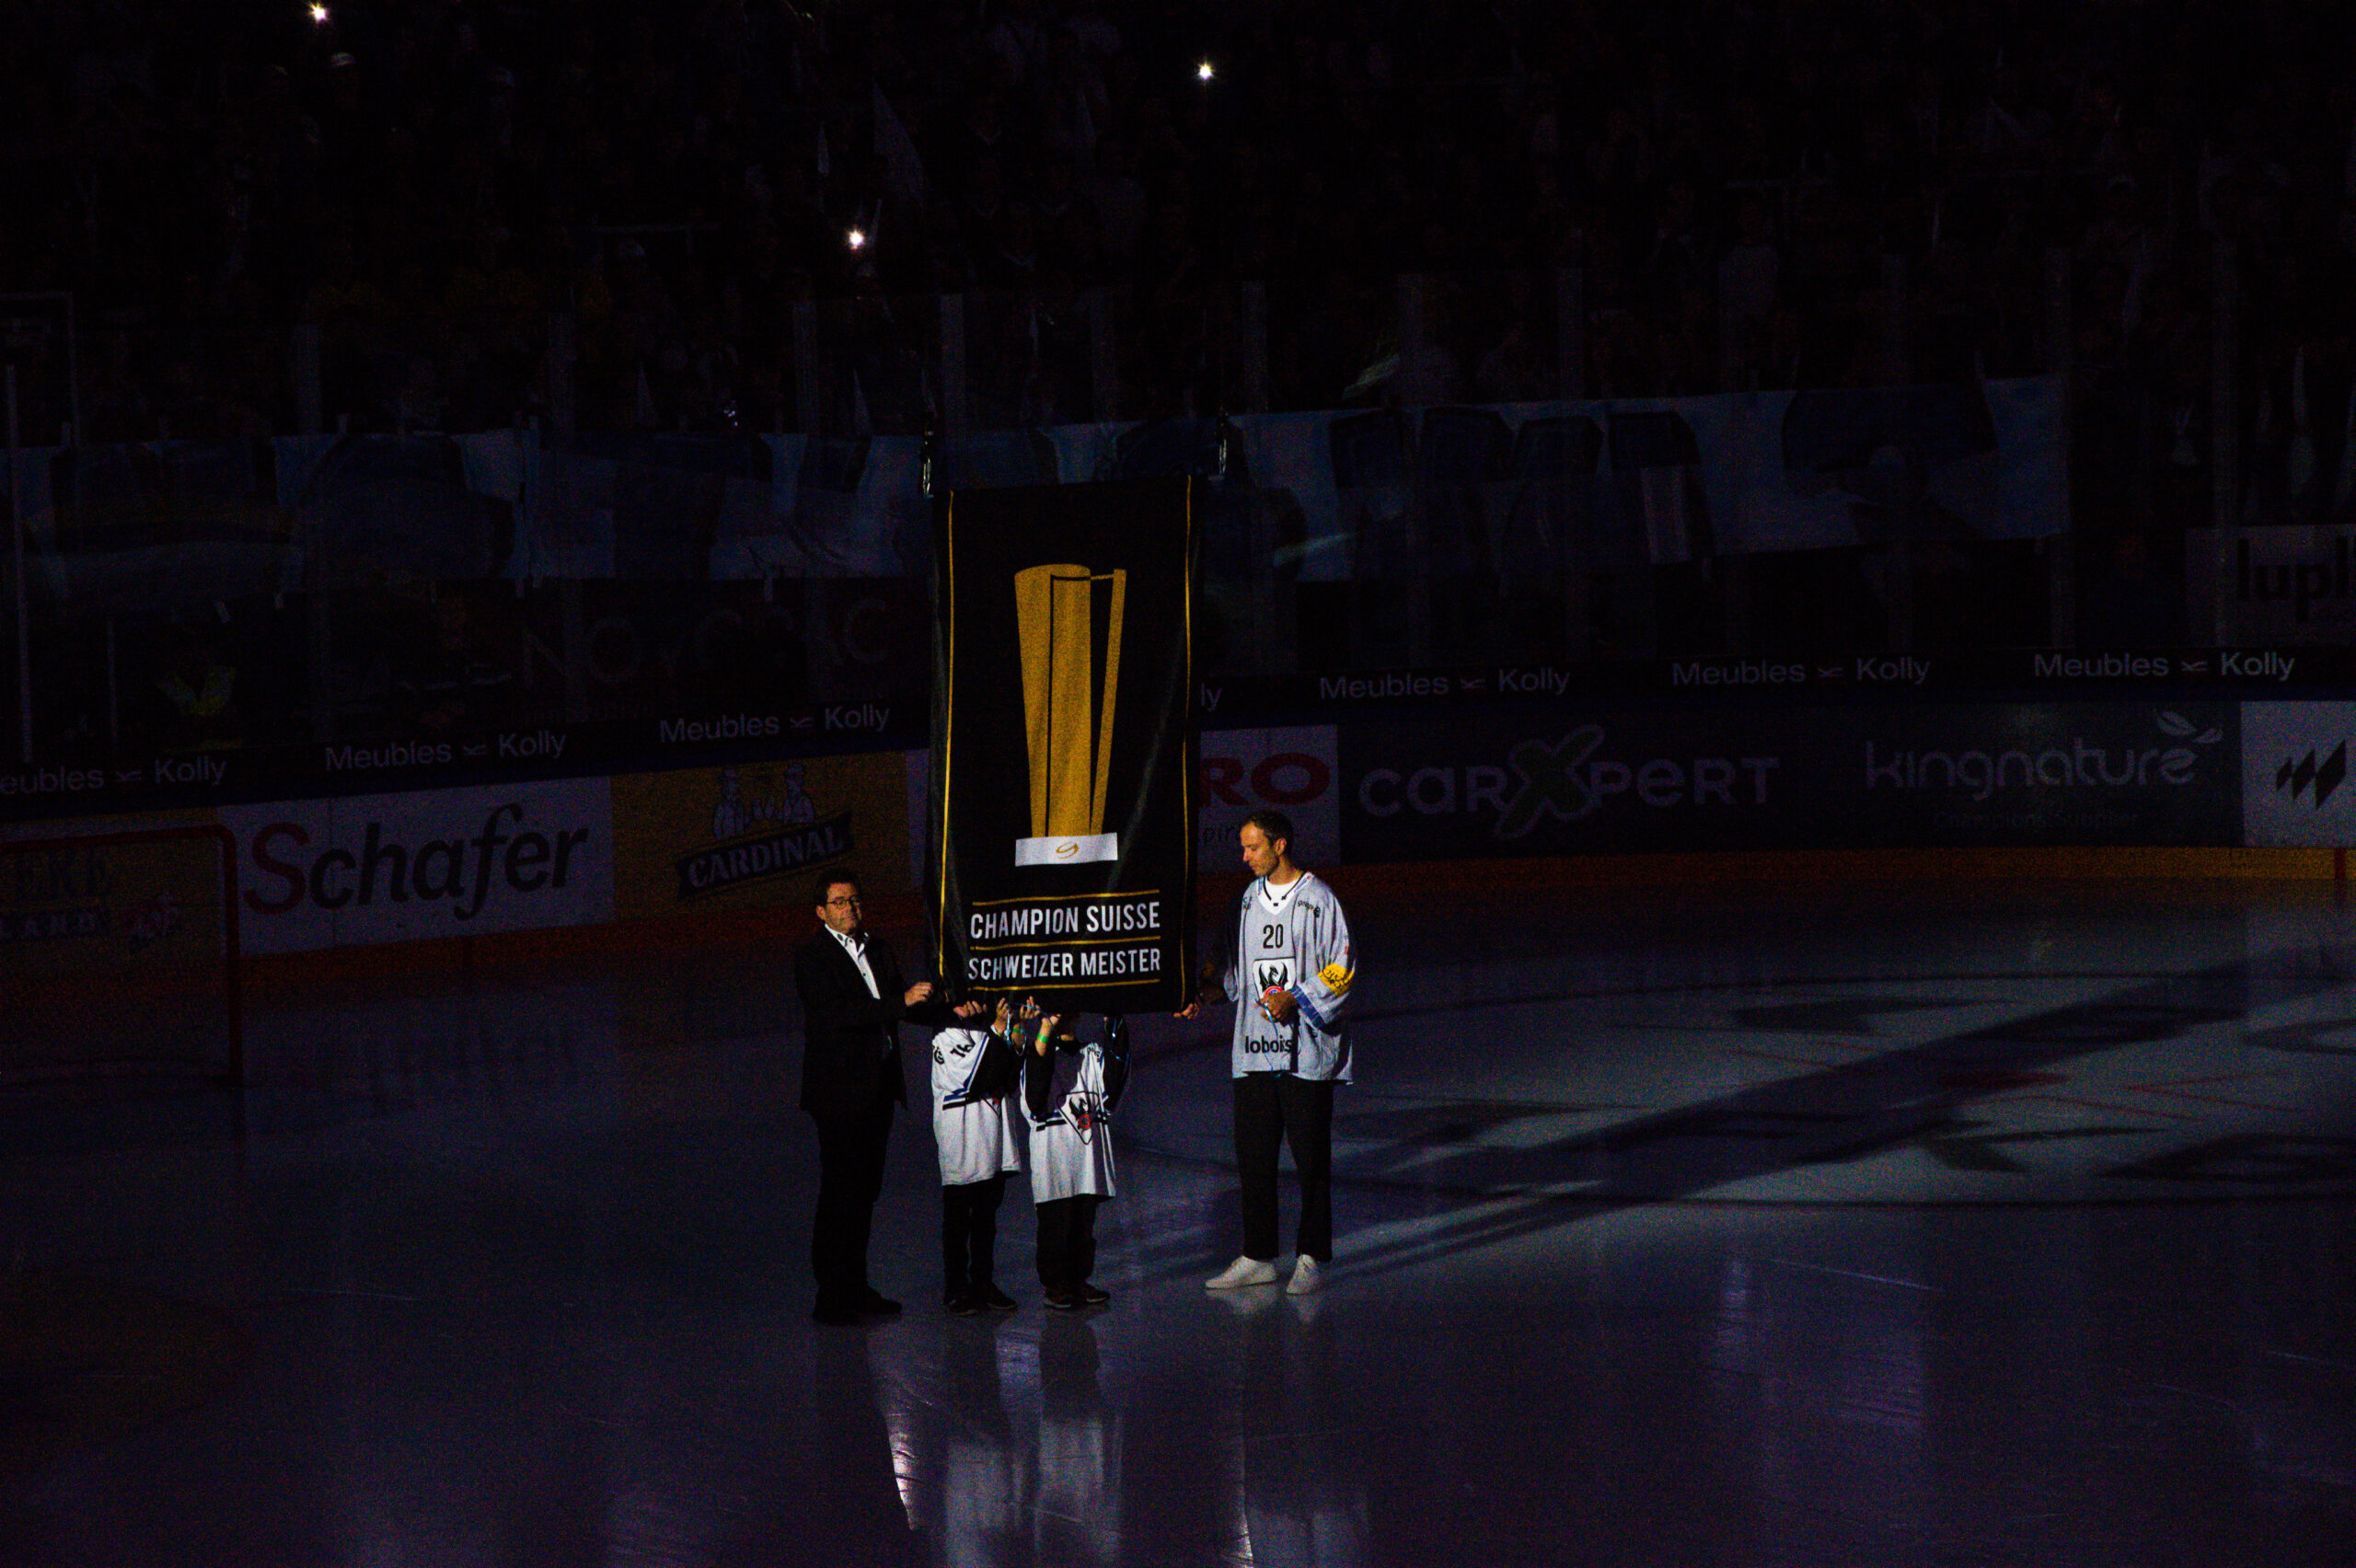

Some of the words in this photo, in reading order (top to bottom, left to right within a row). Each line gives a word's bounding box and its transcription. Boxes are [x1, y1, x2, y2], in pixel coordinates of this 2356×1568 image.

[2238, 536, 2356, 623] lupl
[1319, 674, 1449, 700] Meubles
[1498, 667, 1570, 697] Kolly
[1672, 660, 1807, 686] Meubles
[1856, 656, 1930, 686] Kolly
[2034, 652, 2169, 678] Meubles
[2221, 651, 2295, 682] Kolly
[659, 713, 780, 743] Meubles
[825, 704, 890, 732] Kolly
[326, 741, 452, 771] Meubles
[499, 730, 566, 759] Kolly
[1865, 737, 2198, 802] kingnature
[0, 766, 105, 795] eubles
[155, 755, 227, 787] Kolly
[1199, 753, 1331, 808] RO
[244, 803, 589, 920] Schafer
[688, 826, 844, 888] CARDINAL
[970, 906, 1079, 940] CHAMPION
[1086, 902, 1161, 933] SUISSE
[1263, 924, 1284, 949] 20
[968, 952, 1073, 980] SCHWEIZER
[1080, 948, 1161, 975] MEISTER
